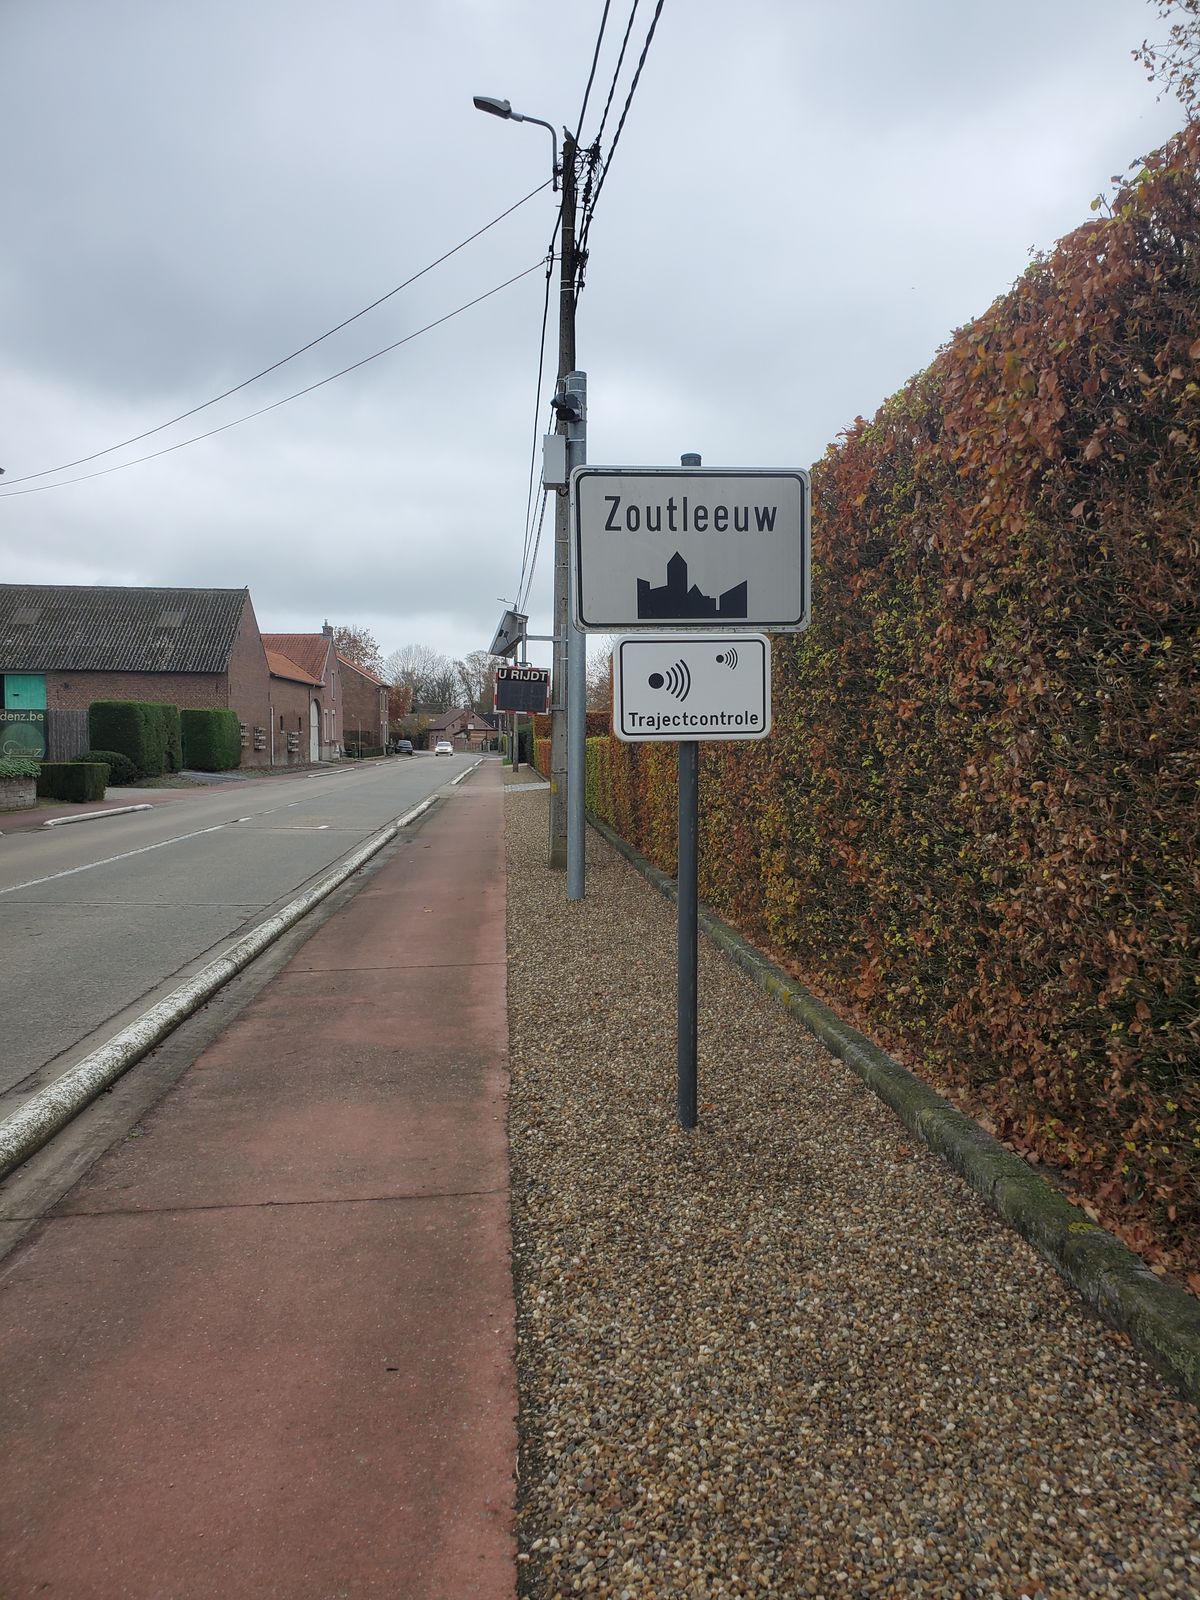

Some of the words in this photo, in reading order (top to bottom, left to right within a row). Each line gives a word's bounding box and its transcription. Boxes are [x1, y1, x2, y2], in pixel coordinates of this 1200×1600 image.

[604, 495, 778, 533] Zoutleeuw
[498, 669, 508, 679] U
[510, 670, 548, 681] RIJDT
[628, 710, 759, 731] Trajectcontrole
